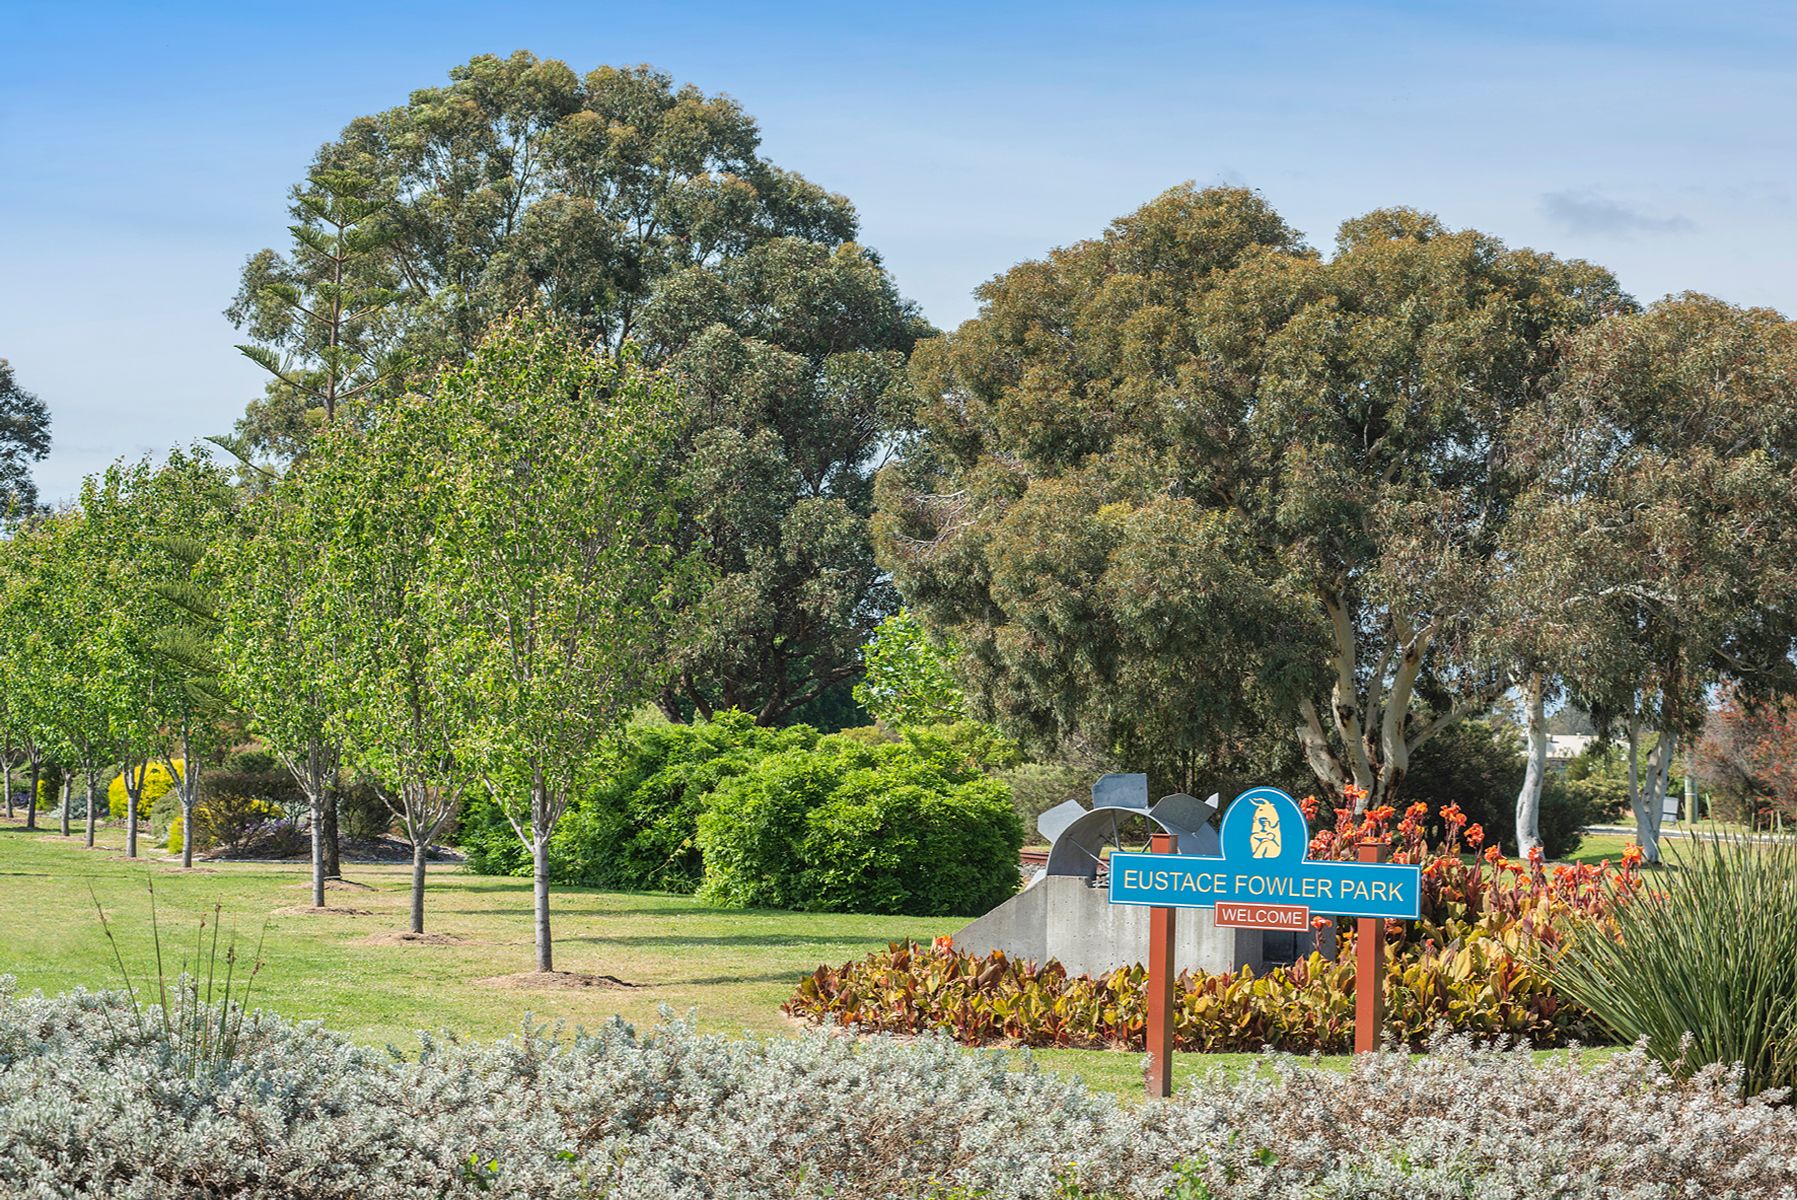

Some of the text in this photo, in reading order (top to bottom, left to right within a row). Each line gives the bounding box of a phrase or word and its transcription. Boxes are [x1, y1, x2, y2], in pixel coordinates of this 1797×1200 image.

[1123, 870, 1404, 902] EUSTACE FOWLER PARK
[1221, 908, 1303, 925] WELCOME
